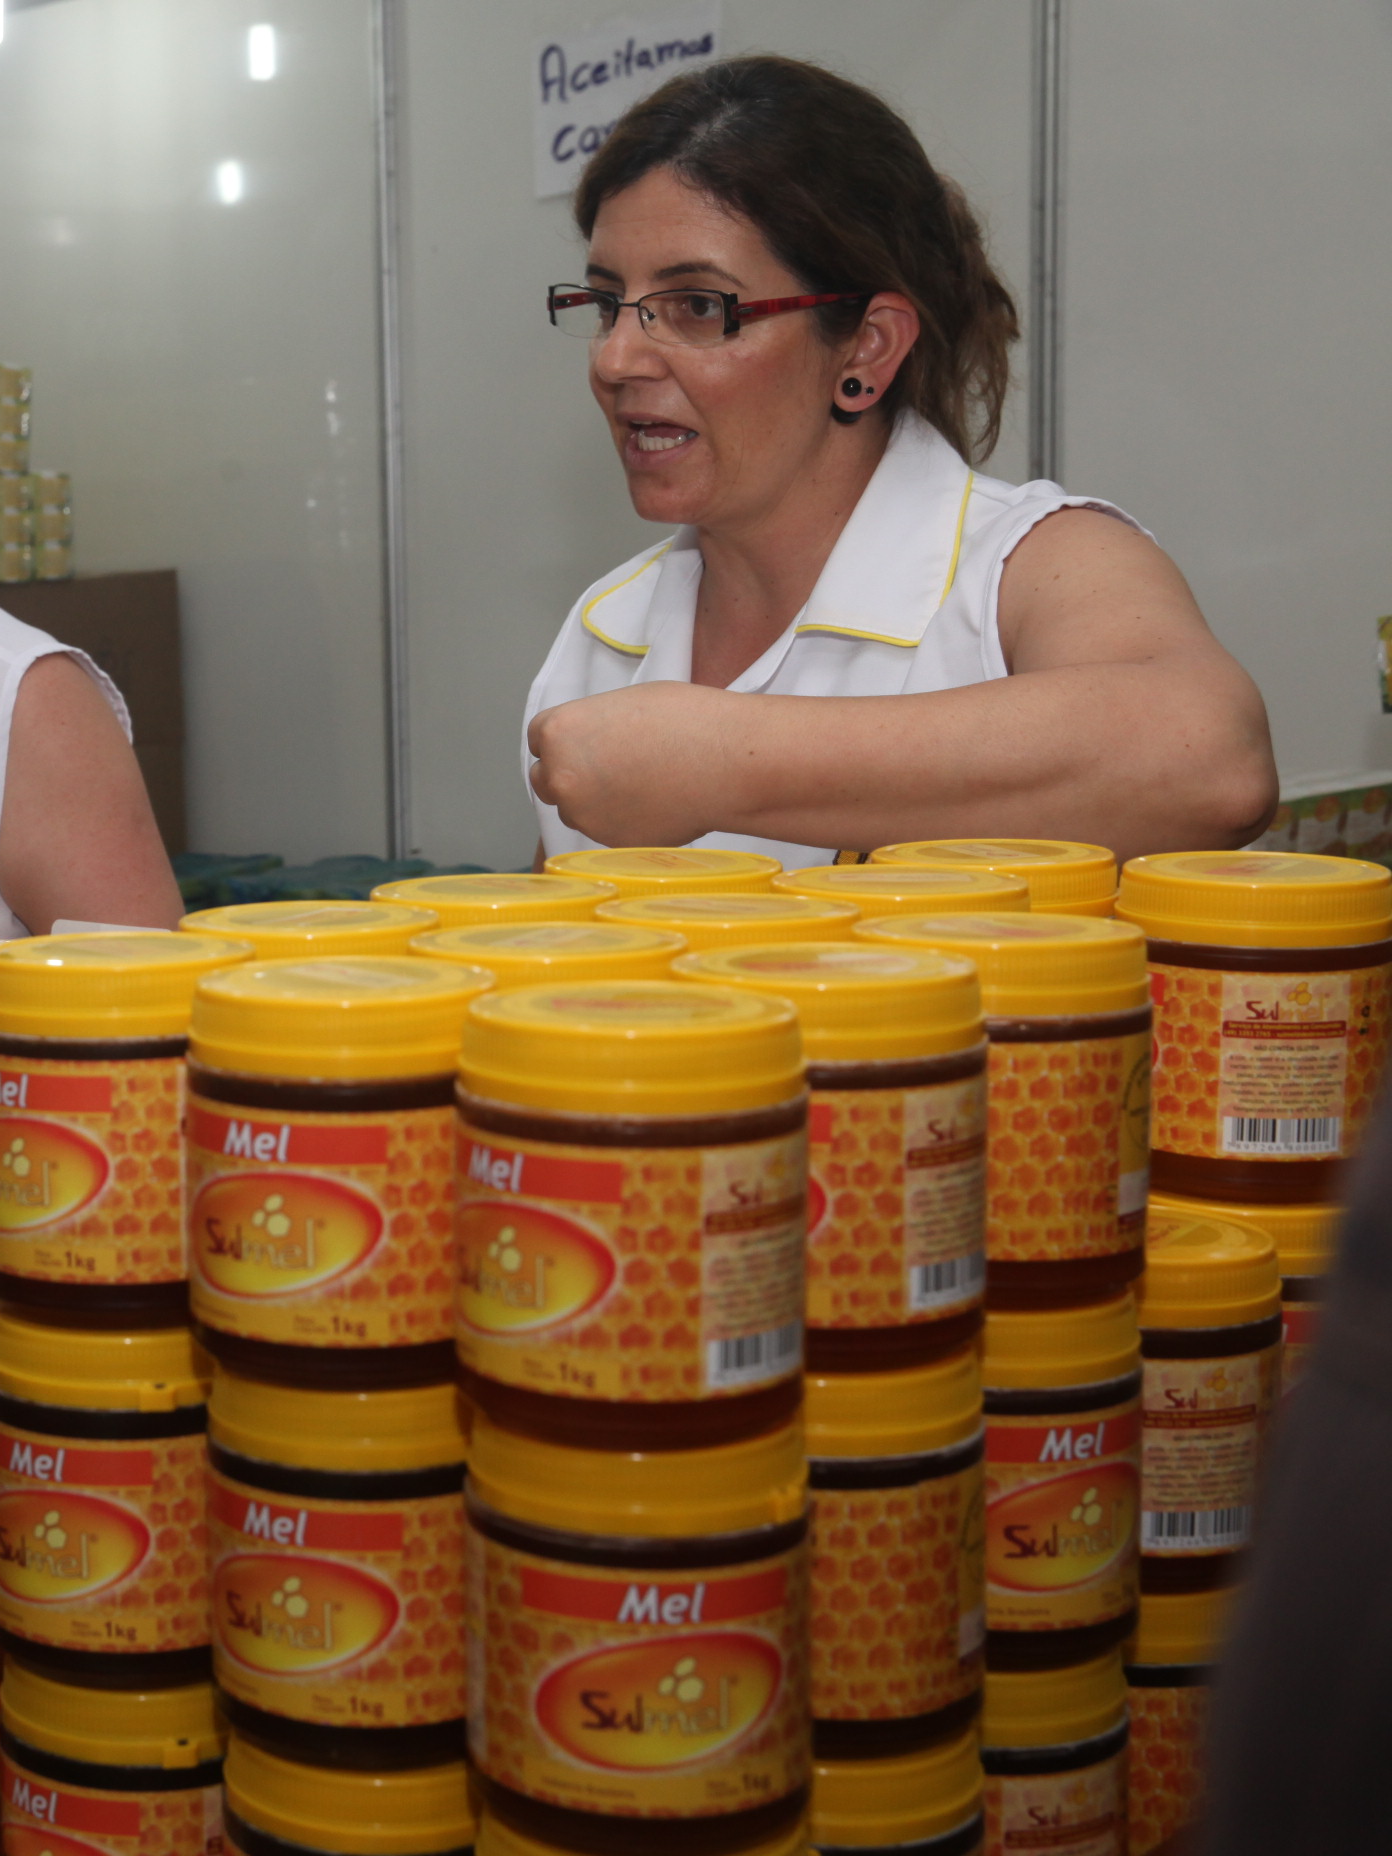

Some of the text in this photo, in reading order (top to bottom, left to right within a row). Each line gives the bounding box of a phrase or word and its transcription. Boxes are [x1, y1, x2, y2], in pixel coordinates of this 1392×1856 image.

[223, 1119, 292, 1164] Mel
[467, 1144, 525, 1194] Mel
[65, 1249, 97, 1273] 1kg
[331, 1315, 368, 1339] 1kg
[559, 1361, 597, 1390] 1kg
[9, 1441, 65, 1483] Mel
[1039, 1422, 1105, 1463] Mel
[243, 1501, 307, 1547] Mel
[616, 1581, 706, 1626] Mel
[103, 1621, 137, 1641] 1kg
[349, 1696, 384, 1718] 1kg
[11, 1777, 59, 1824] Mel
